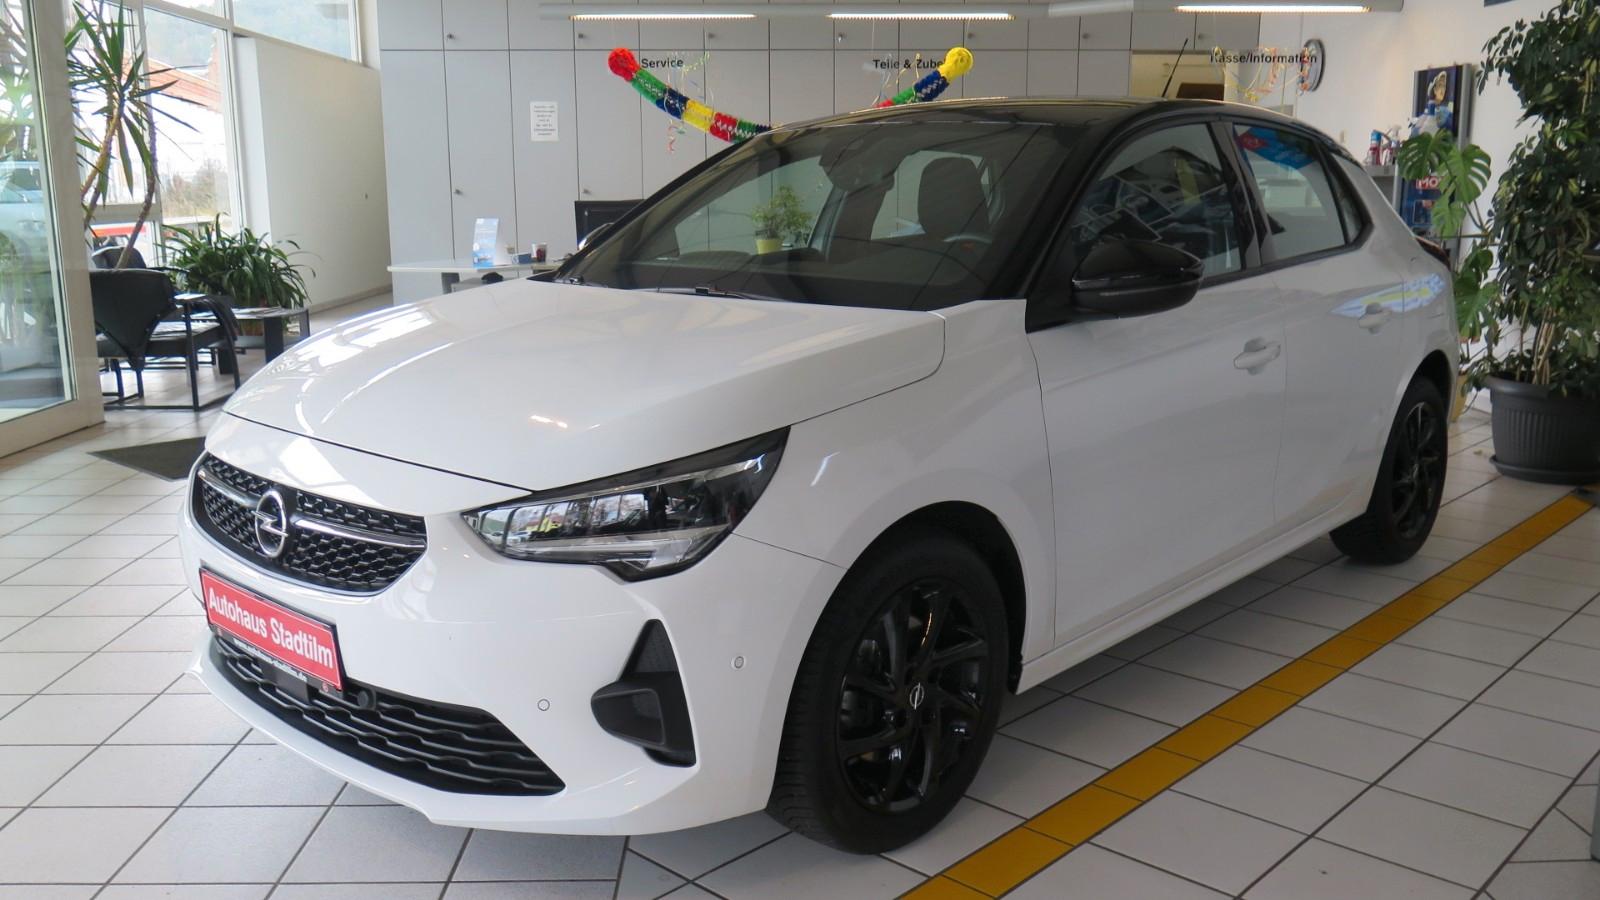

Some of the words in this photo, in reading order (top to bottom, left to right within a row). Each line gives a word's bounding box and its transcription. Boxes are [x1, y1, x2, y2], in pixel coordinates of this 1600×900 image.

[641, 58, 684, 68] Service
[873, 59, 899, 69] Teile
[904, 59, 911, 69] &
[916, 59, 944, 69] Zube
[209, 587, 268, 638] Autohaus
[270, 617, 334, 669] Stadtilm
